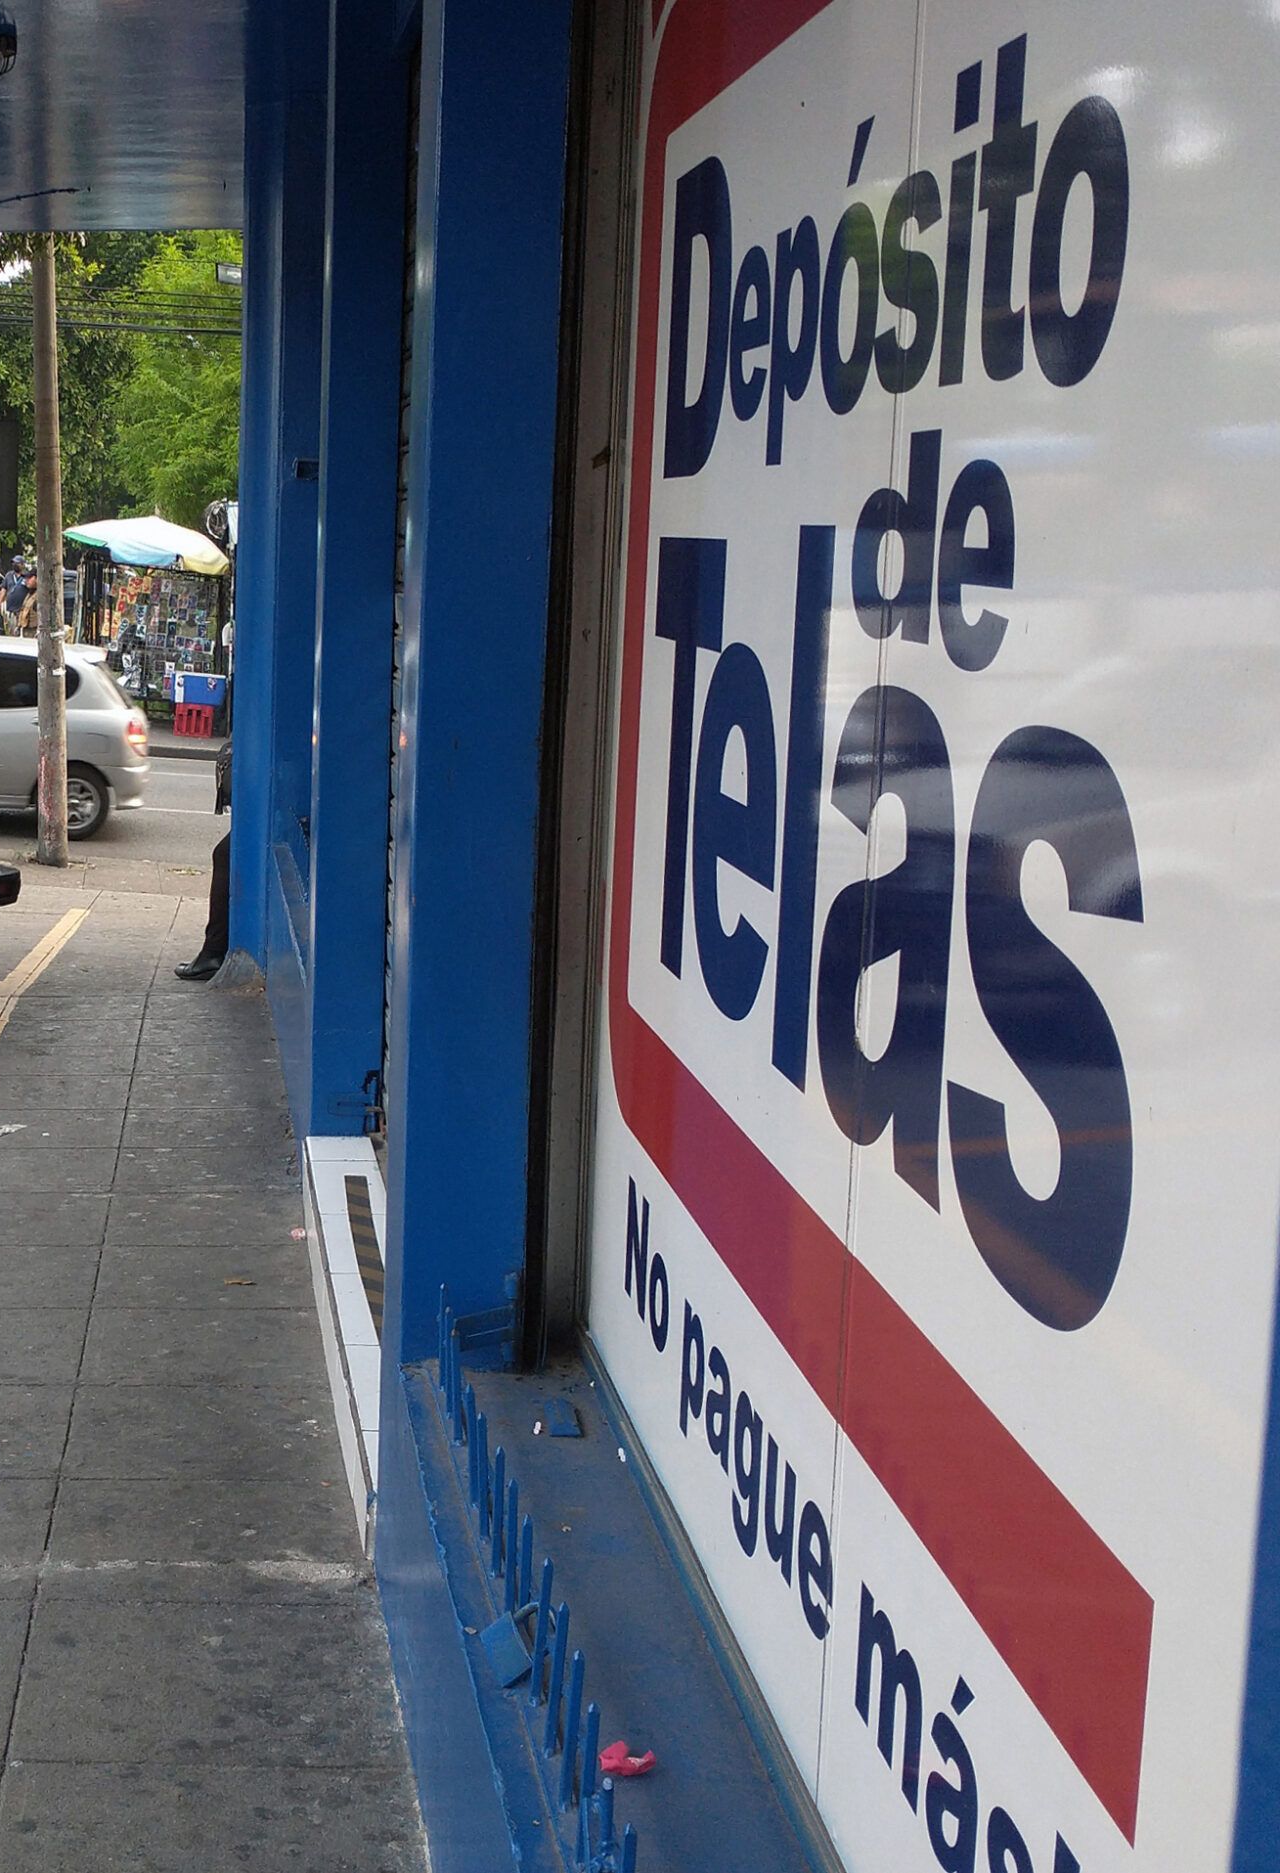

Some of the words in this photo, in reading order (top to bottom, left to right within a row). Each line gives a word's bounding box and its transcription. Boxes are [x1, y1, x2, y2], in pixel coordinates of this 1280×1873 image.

[663, 33, 1130, 479] Depósito
[851, 429, 1015, 672] de
[655, 525, 1144, 1332] Telas
[625, 1176, 669, 1353] No
[680, 1298, 833, 1640] pague
[855, 1581, 1081, 1873] má
